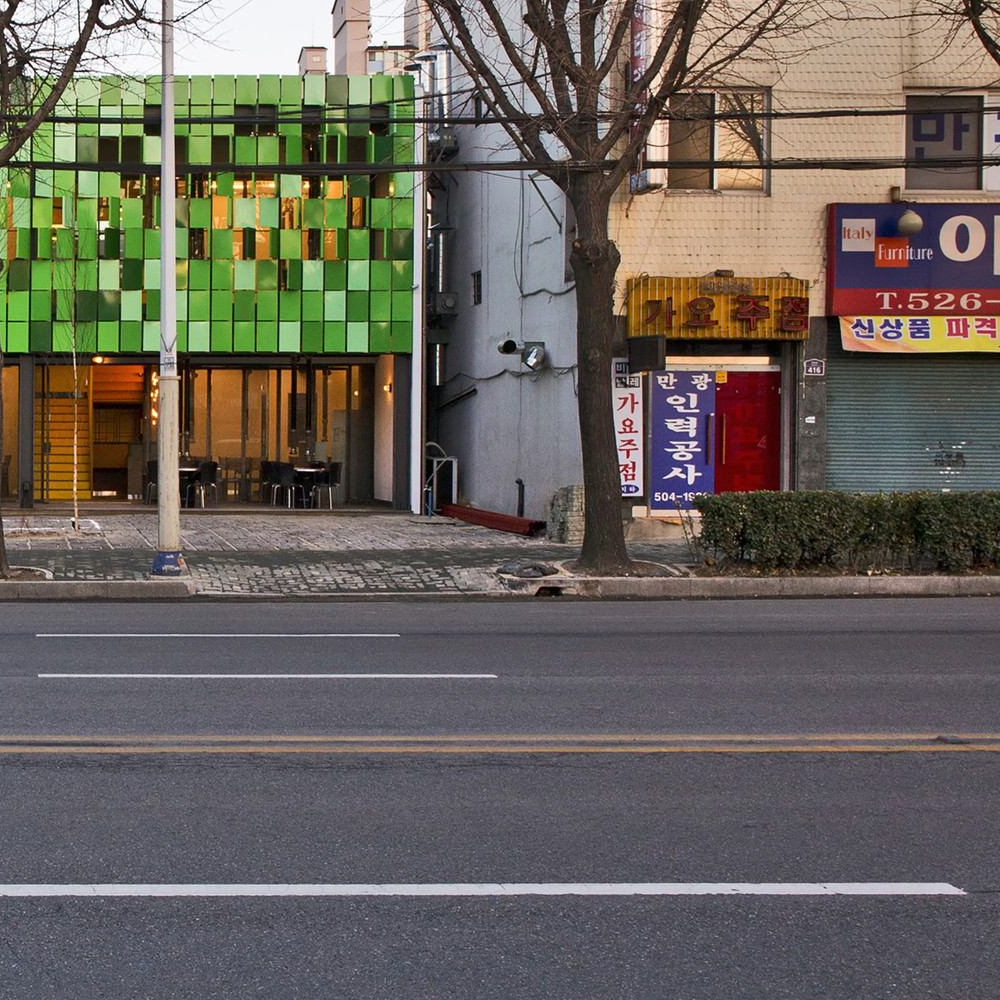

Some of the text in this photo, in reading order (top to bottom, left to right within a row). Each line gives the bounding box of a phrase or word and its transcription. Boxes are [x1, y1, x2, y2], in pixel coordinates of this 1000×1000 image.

[842, 227, 873, 240] Italy
[878, 244, 934, 260] Furniture
[876, 292, 1000, 310] T.526-
[645, 296, 809, 331] 가요주점
[851, 317, 998, 340] 신상품 파격
[807, 366, 821, 374] 416
[617, 393, 639, 482] 가요주점
[663, 393, 702, 485] 인력공사
